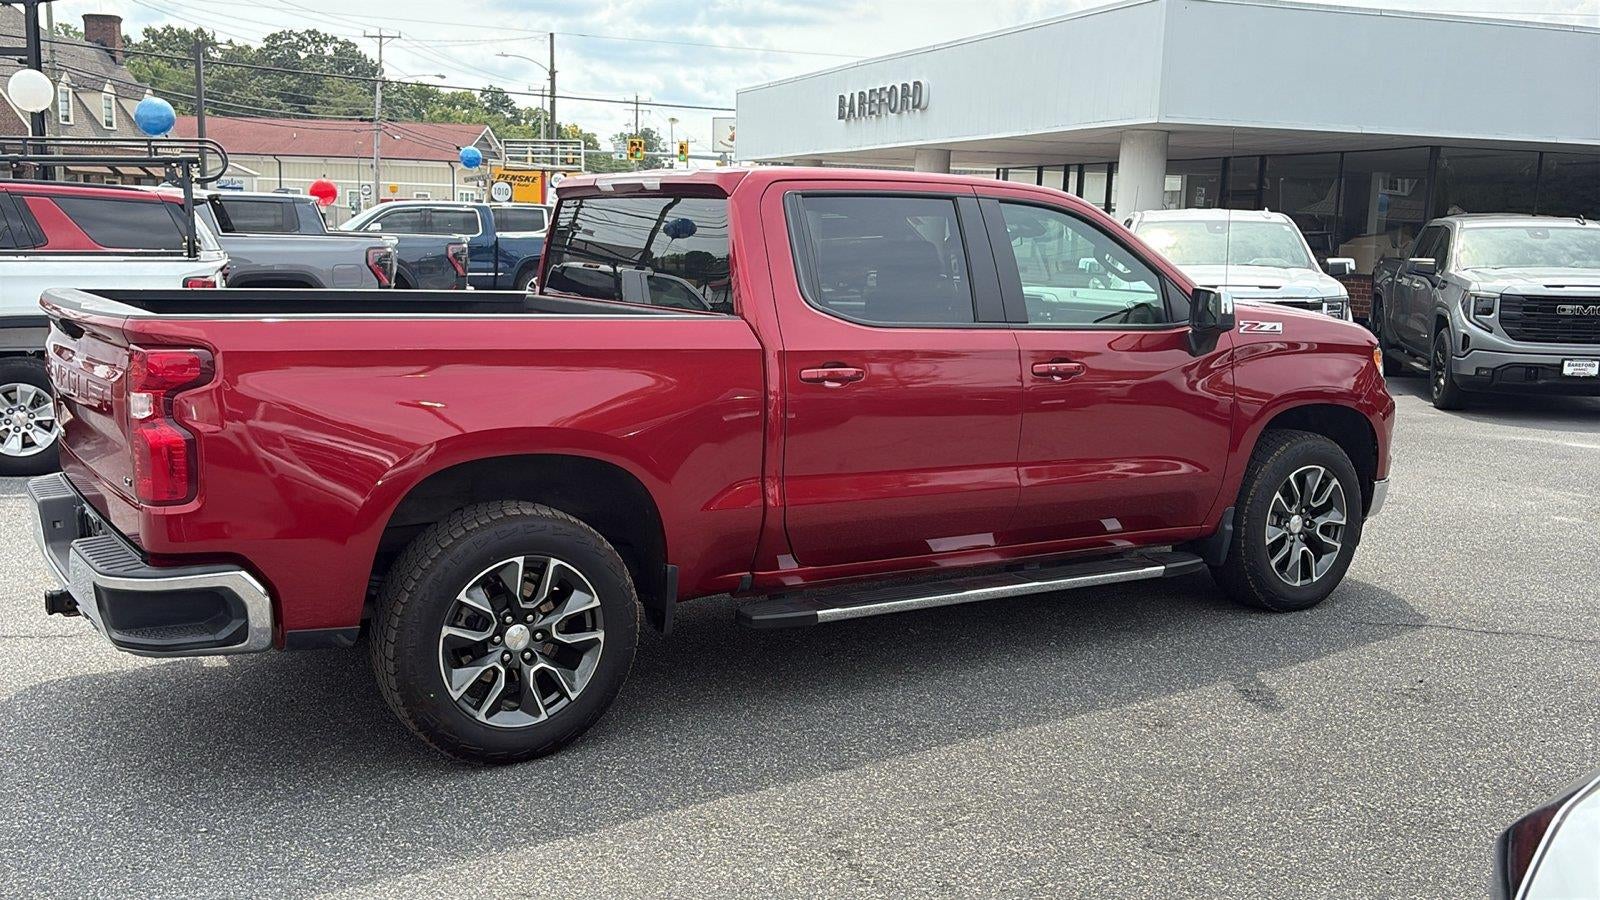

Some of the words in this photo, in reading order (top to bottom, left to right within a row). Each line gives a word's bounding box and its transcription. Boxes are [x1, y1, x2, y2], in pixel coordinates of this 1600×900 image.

[838, 80, 926, 120] BAREFORD
[496, 173, 539, 183] PENSKE
[494, 187, 509, 196] 1010
[1556, 304, 1600, 316] GM
[1239, 320, 1283, 335] Z71
